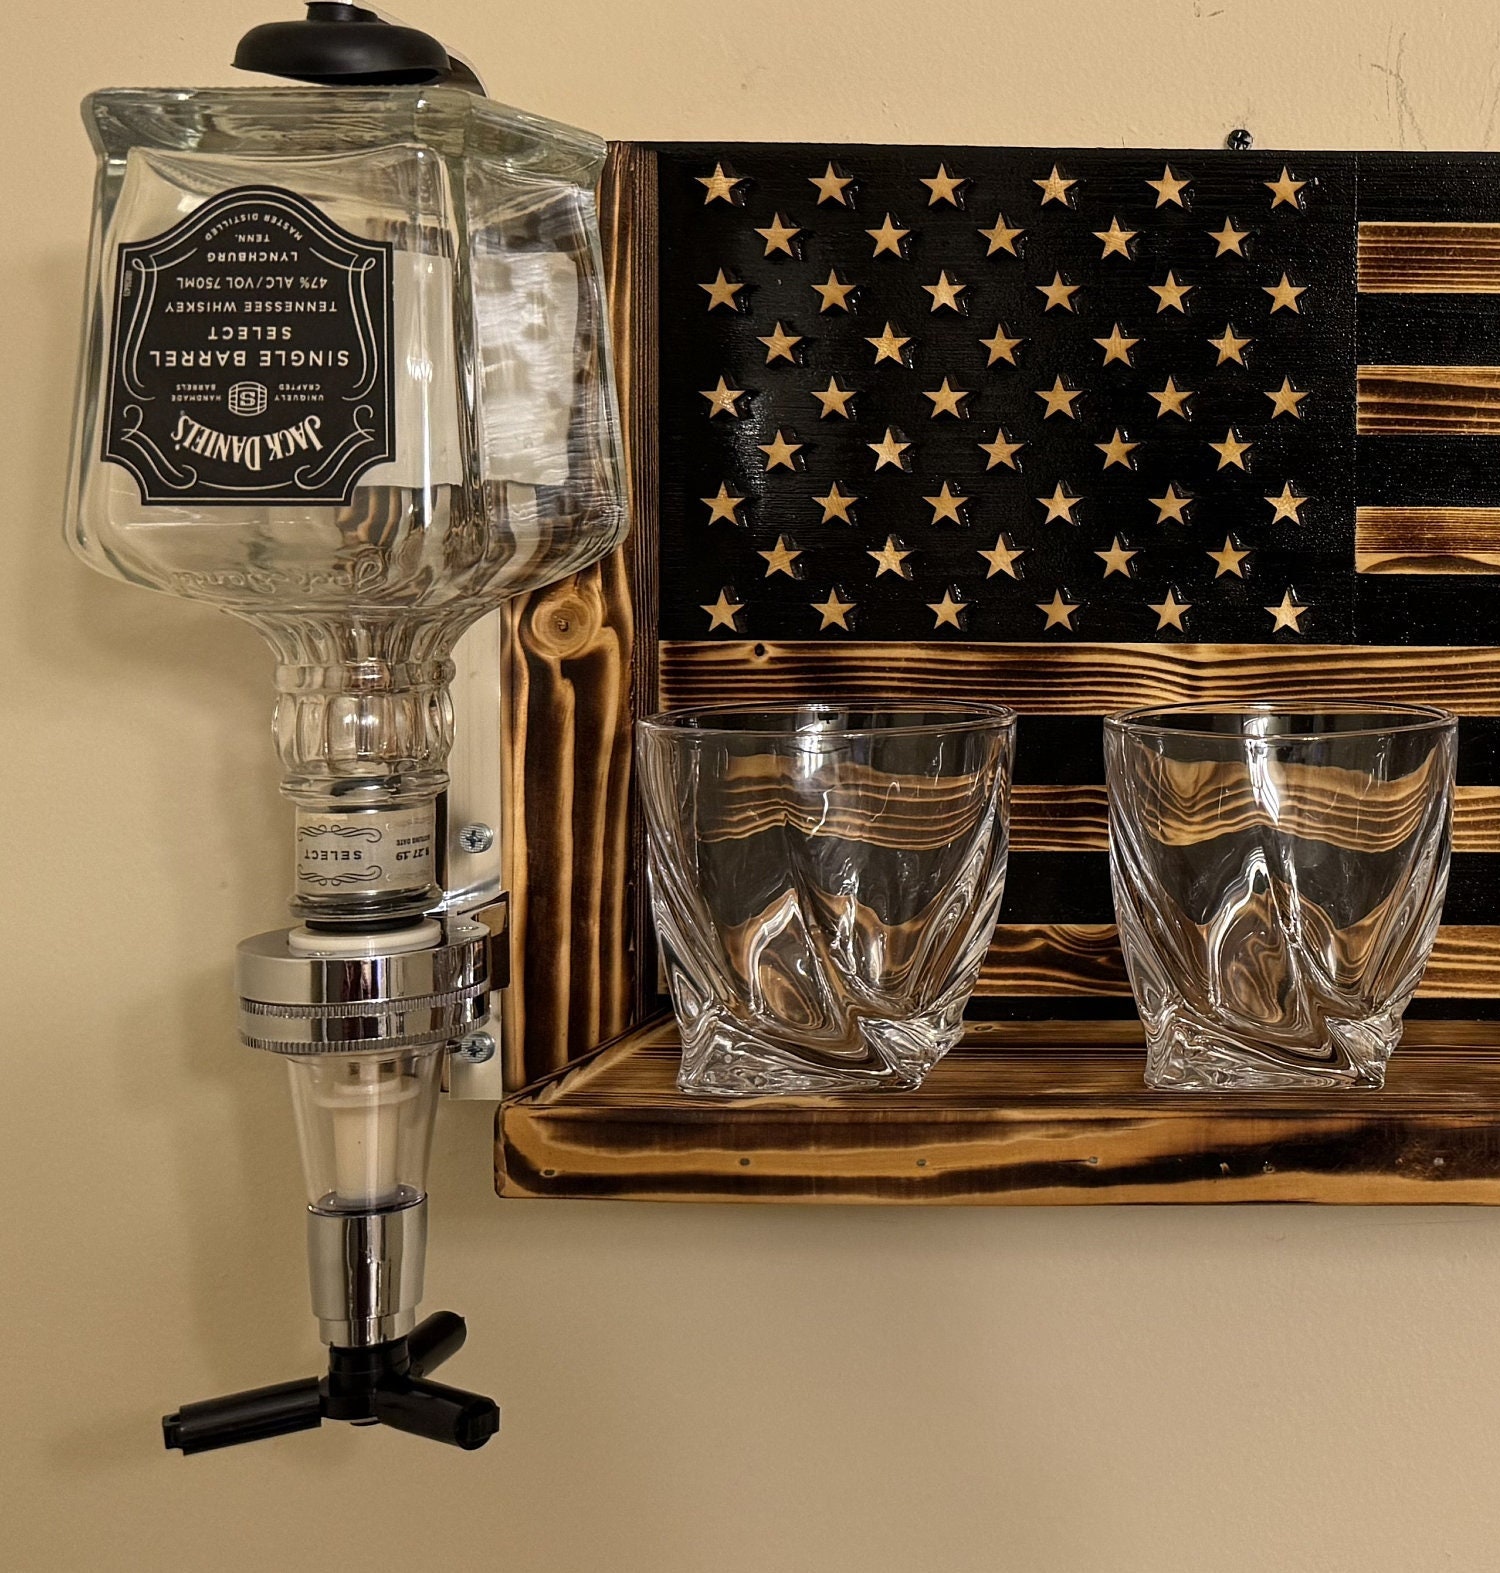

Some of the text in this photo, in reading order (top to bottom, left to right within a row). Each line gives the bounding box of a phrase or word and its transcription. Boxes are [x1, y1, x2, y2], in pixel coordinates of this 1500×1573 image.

[205, 212, 303, 241] MASTER DISTILLED
[235, 234, 270, 242] TENN.
[207, 252, 298, 262] LYNCHBURG
[177, 276, 328, 290] 47% ALC/VOL 750ML
[165, 301, 337, 313] TENNESSEE WHISKEY
[208, 327, 292, 340] SELECT
[150, 350, 349, 366] SINGLE BARREL
[171, 415, 324, 471] JACK DANIEL'S
[304, 850, 362, 860] SELECT
